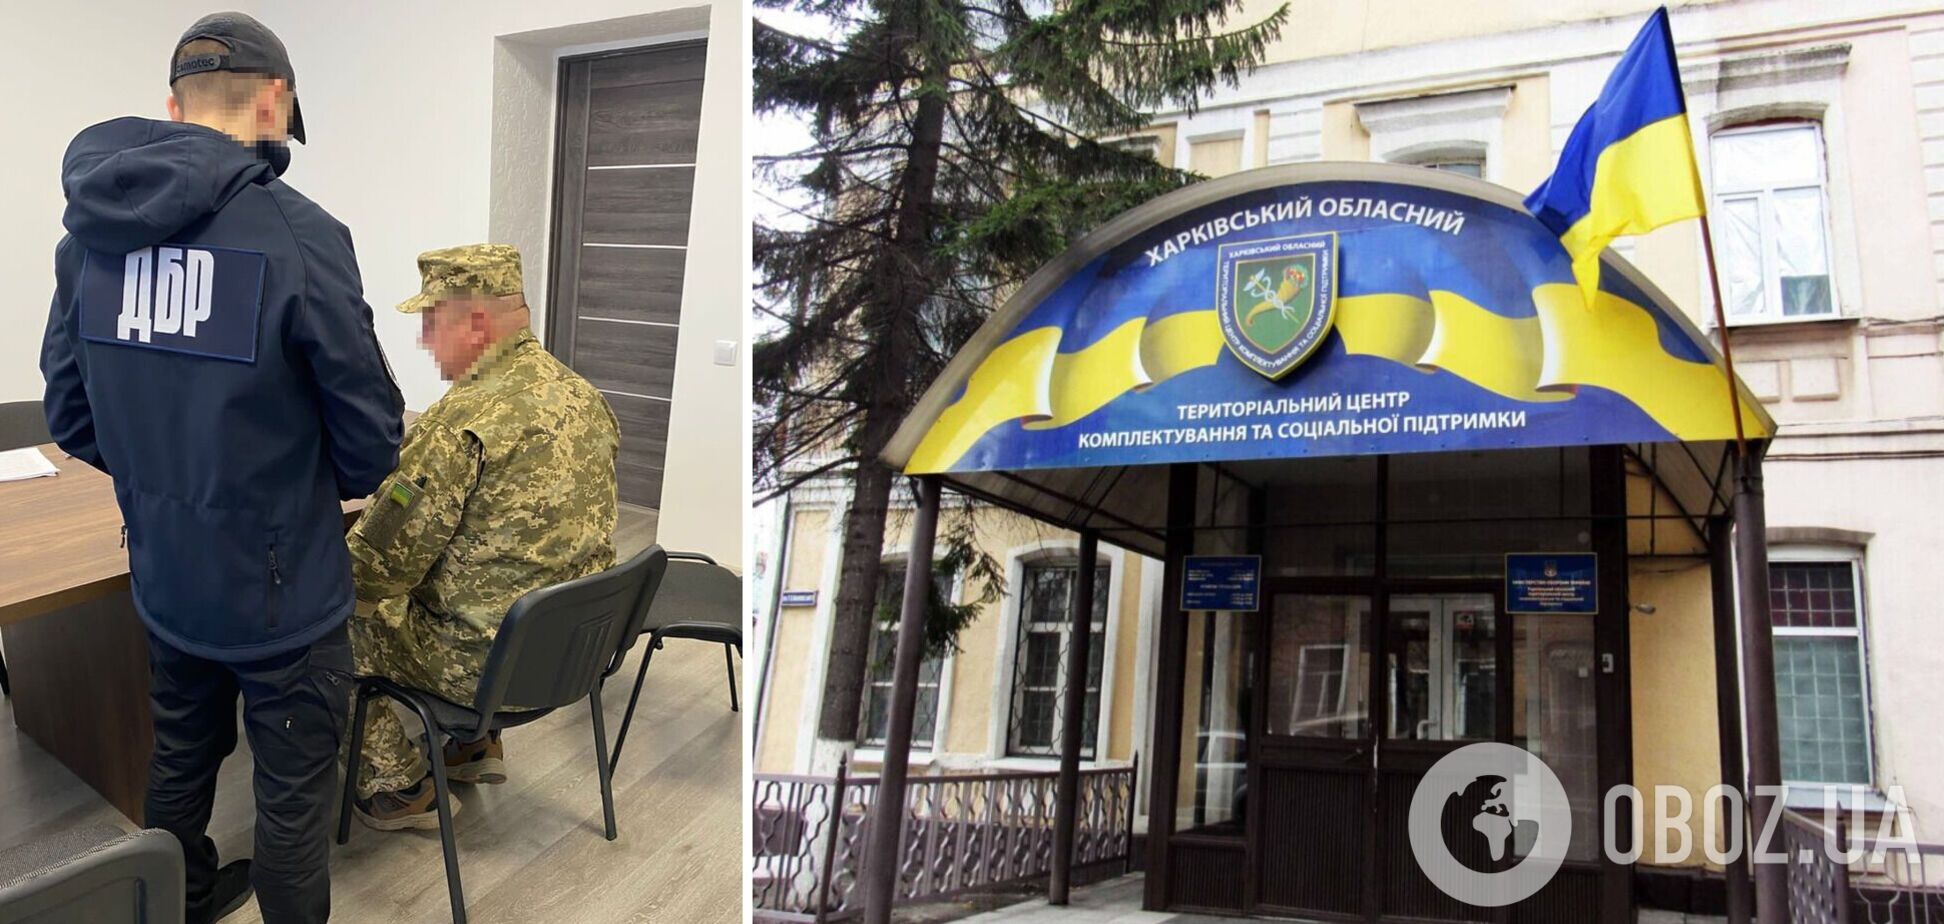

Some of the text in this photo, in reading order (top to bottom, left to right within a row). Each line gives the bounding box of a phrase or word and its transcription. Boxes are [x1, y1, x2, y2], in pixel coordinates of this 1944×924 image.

[1144, 196, 1466, 267] ХАРКІВСЬКИЙ ОБЛАСНИЙ
[1229, 240, 1326, 259] ХАРКІВСЬКИЙ ОБЛАСНИЙ
[116, 246, 214, 343] ДБР
[1177, 391, 1410, 420] ТЕРИТОРІАЛЬНИЙ ЦЕНТР
[1078, 411, 1527, 448] КОМПЛЕКТУВАННЯ ТА СОЦІАЛЬНОЇ ПІДТРИМКИ
